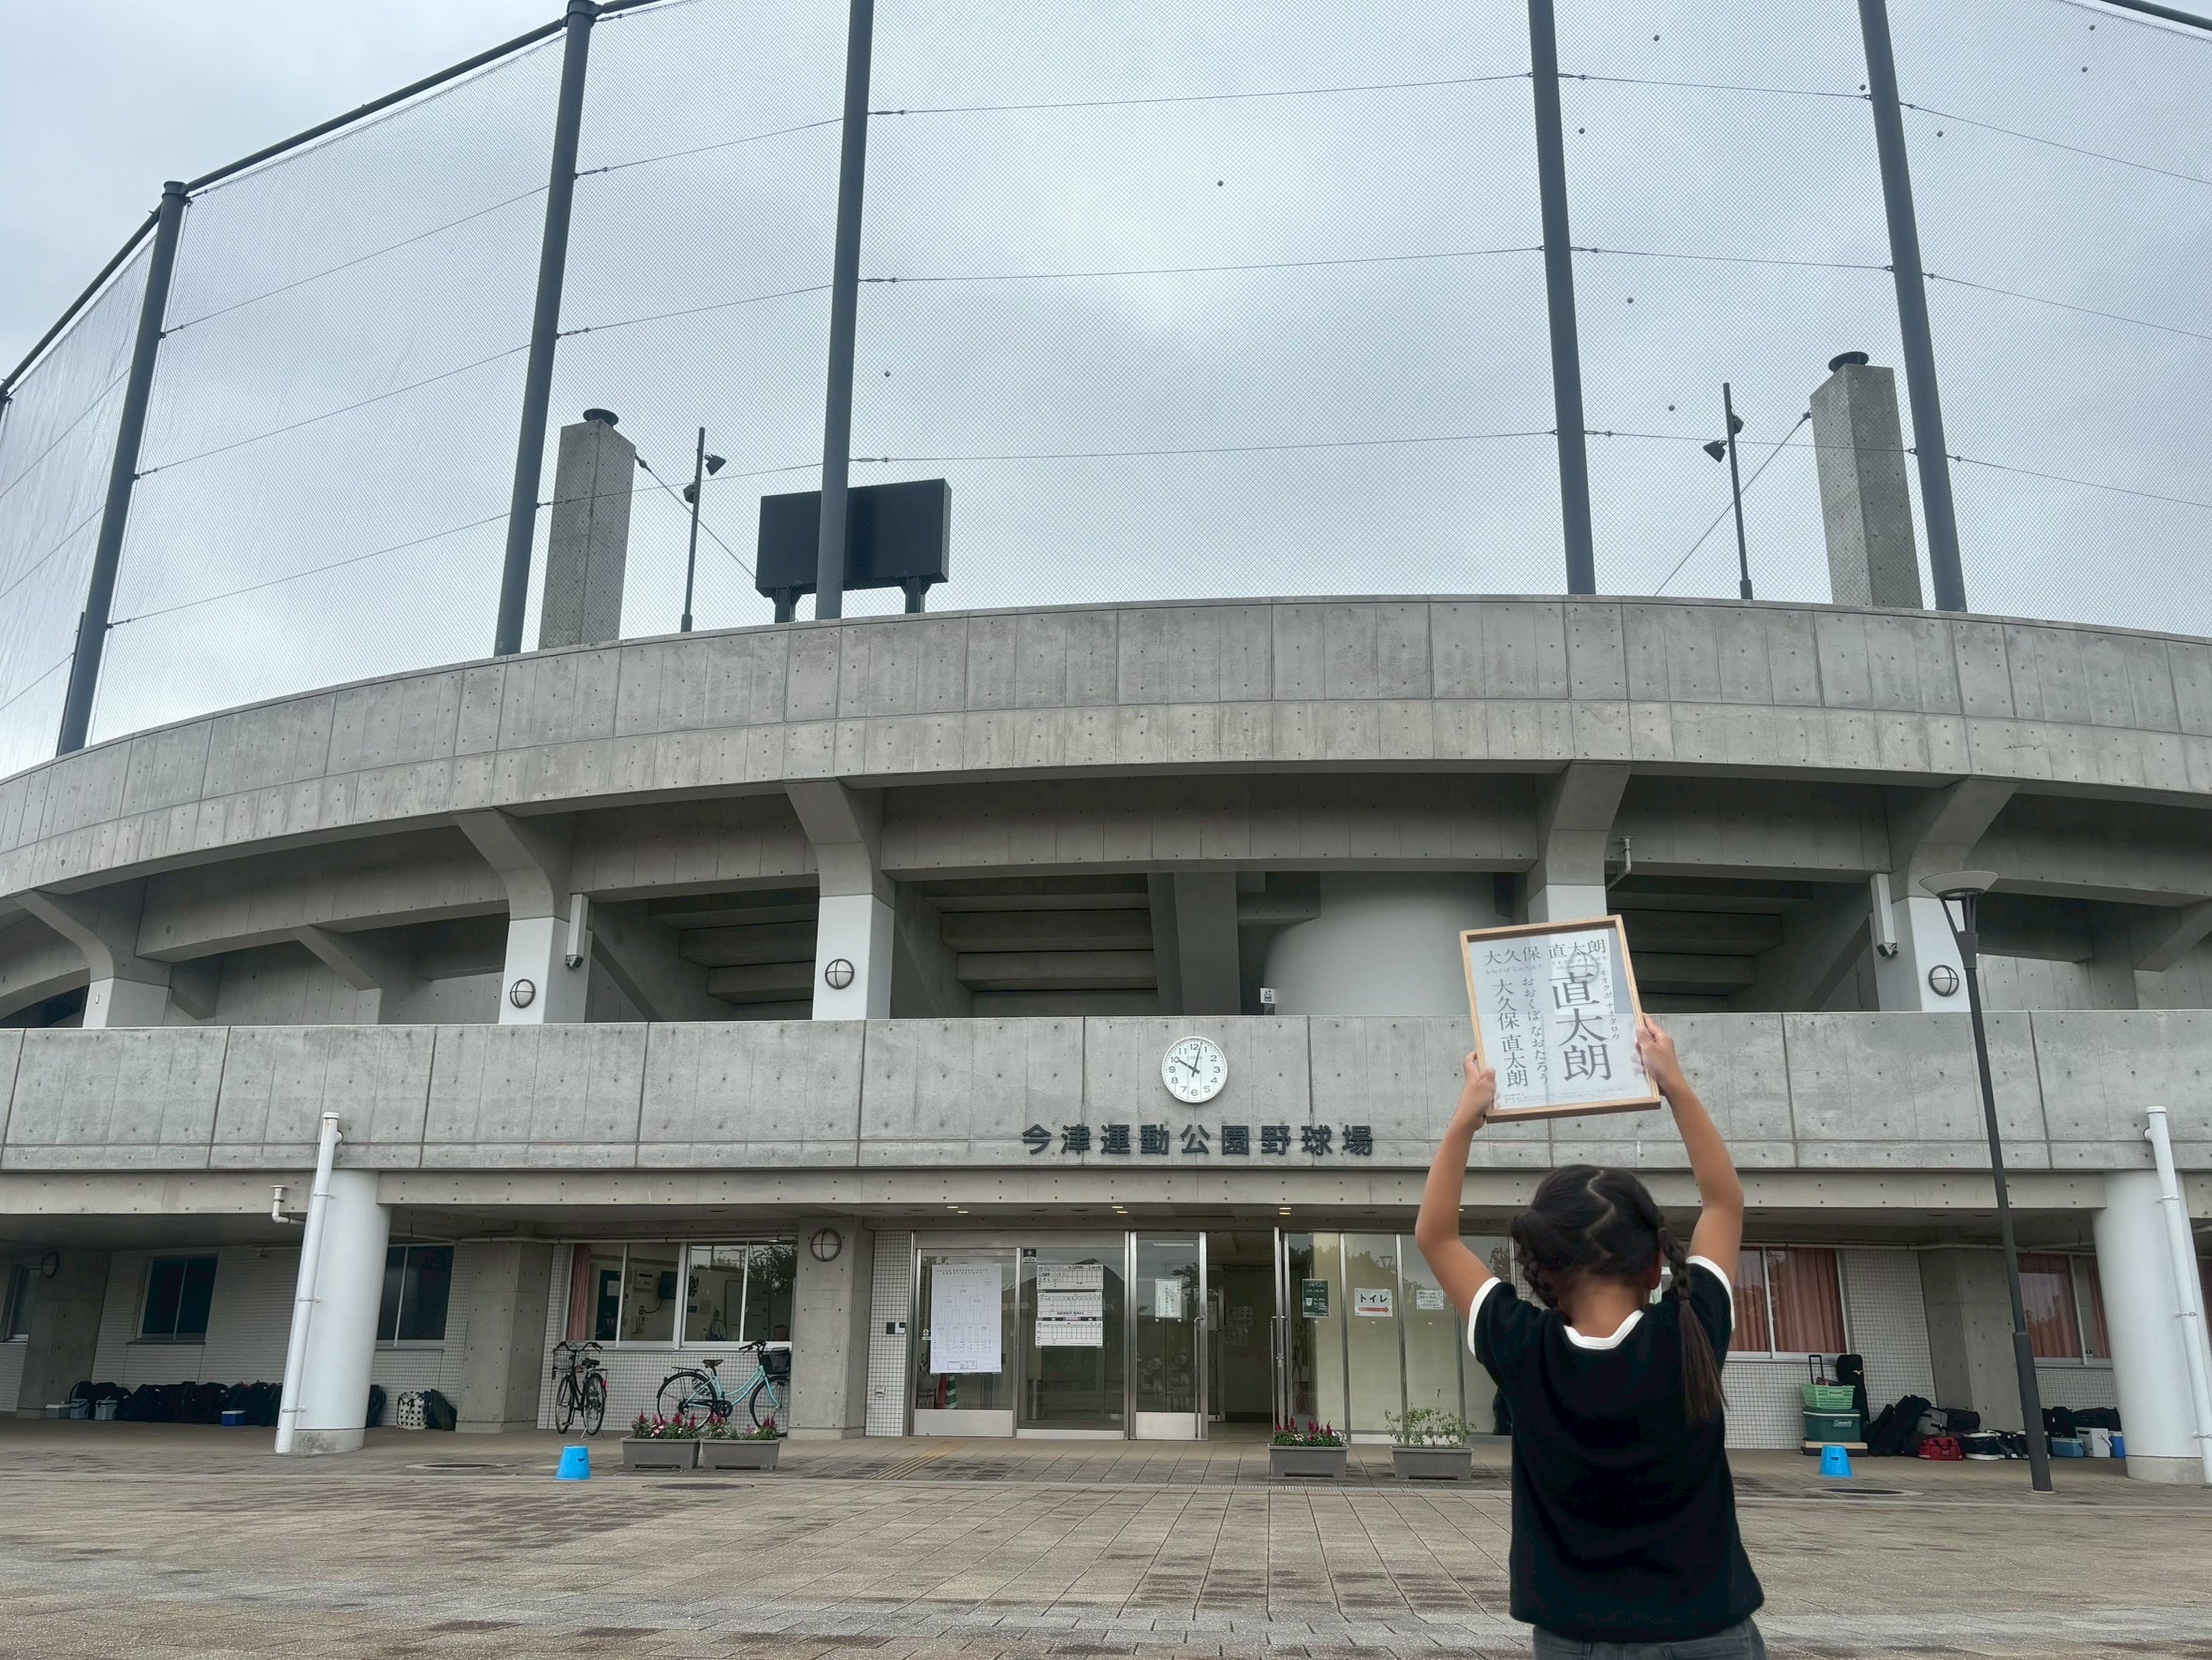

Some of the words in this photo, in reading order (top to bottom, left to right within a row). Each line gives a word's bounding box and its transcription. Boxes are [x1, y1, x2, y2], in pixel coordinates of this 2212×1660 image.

[1483, 945, 1541, 967] 大久保
[1547, 939, 1607, 959] 直太朗
[1492, 978, 1521, 1031] 大久保
[1521, 977, 1541, 1022] おおくぼ
[1531, 1026, 1549, 1084] なおたろう
[1548, 971, 1611, 1082] 直太朗
[1500, 1034, 1529, 1087] 直太朗
[1171, 1076, 1179, 1085] 8
[1190, 1088, 1199, 1097] 6
[1022, 1123, 1374, 1157] 今津運動公園野球場
[1360, 1293, 1388, 1303] トイレ
